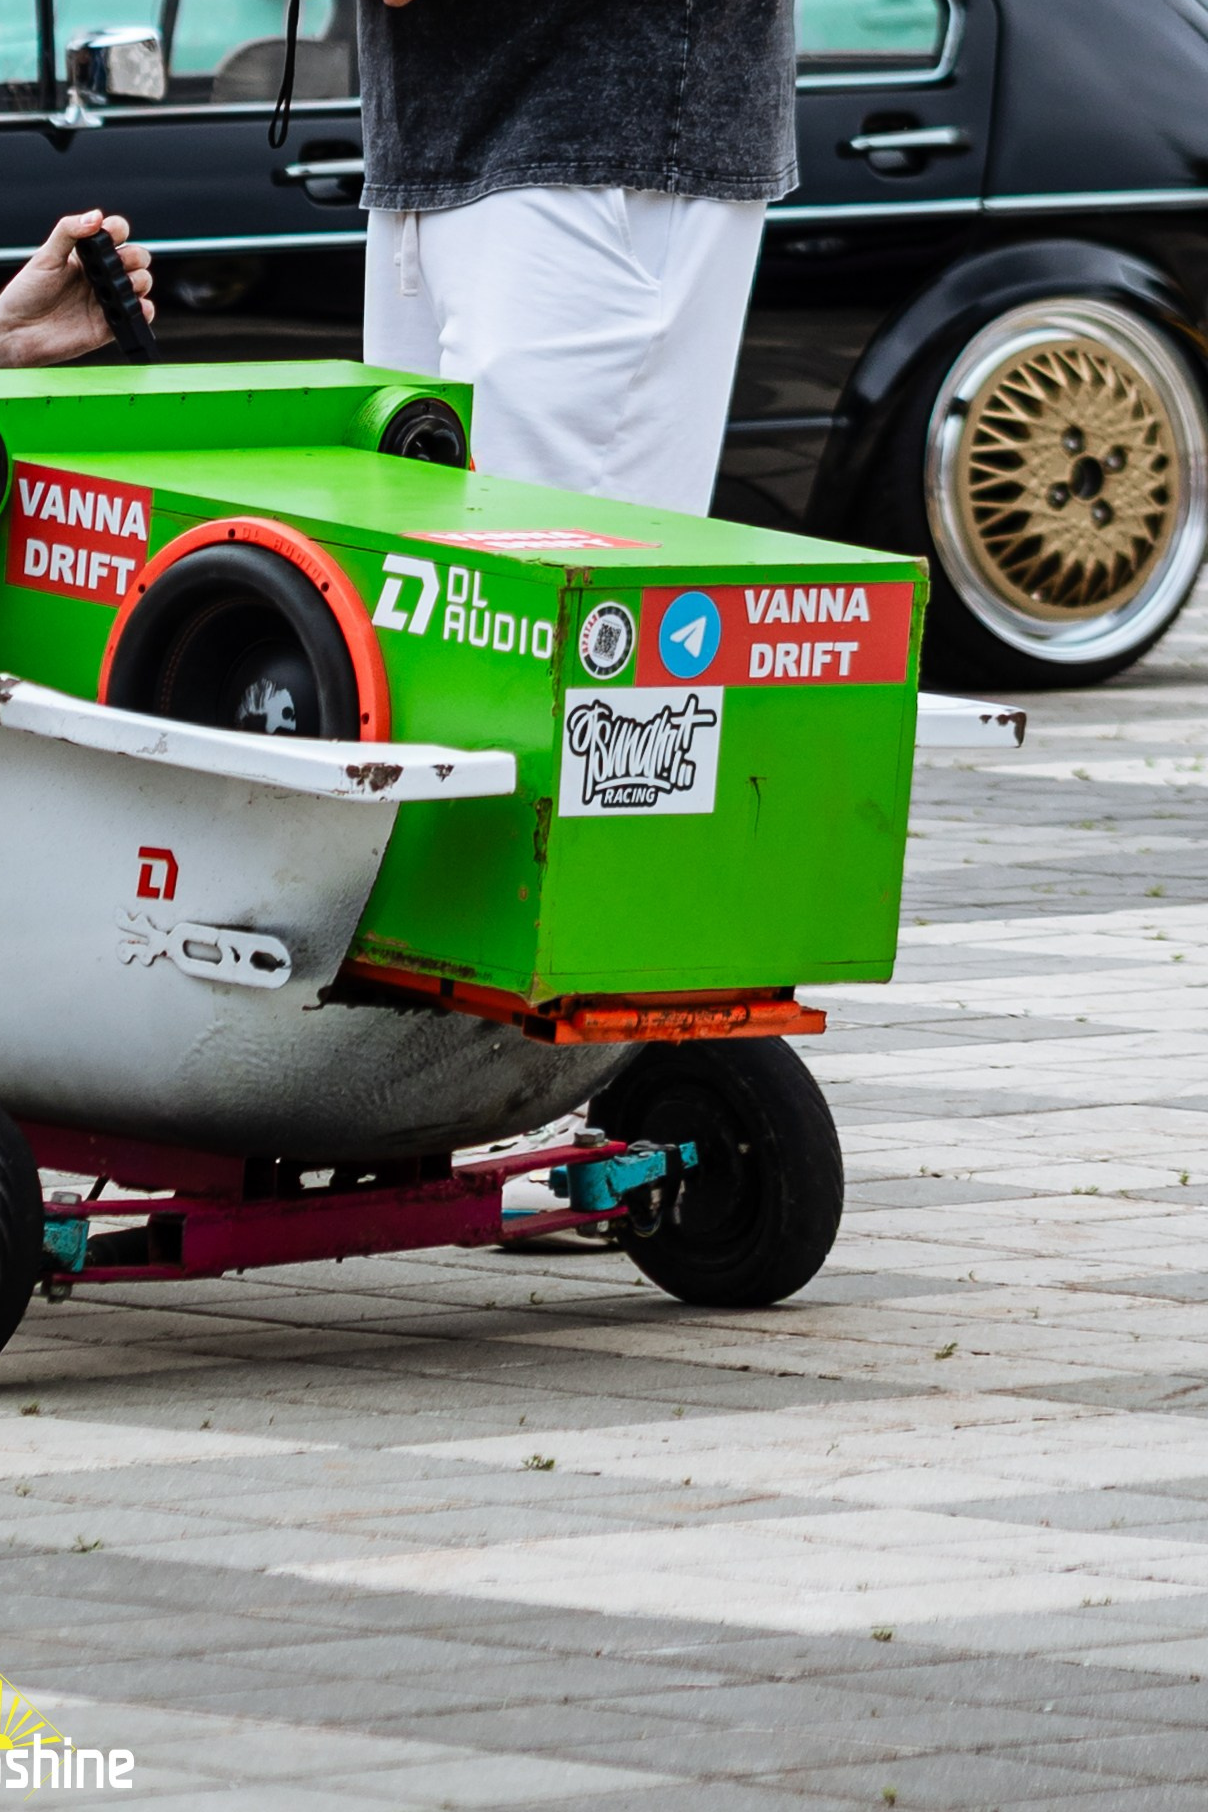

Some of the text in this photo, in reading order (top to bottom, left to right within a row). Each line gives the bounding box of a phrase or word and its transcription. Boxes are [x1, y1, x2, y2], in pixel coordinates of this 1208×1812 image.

[18, 477, 148, 542] VANNA
[23, 538, 136, 596] DRIFT
[447, 565, 488, 609] DL
[744, 587, 871, 624] VANNA
[443, 604, 554, 660] AUDIO
[748, 641, 859, 679] DRIFT
[603, 788, 657, 804] RACING
